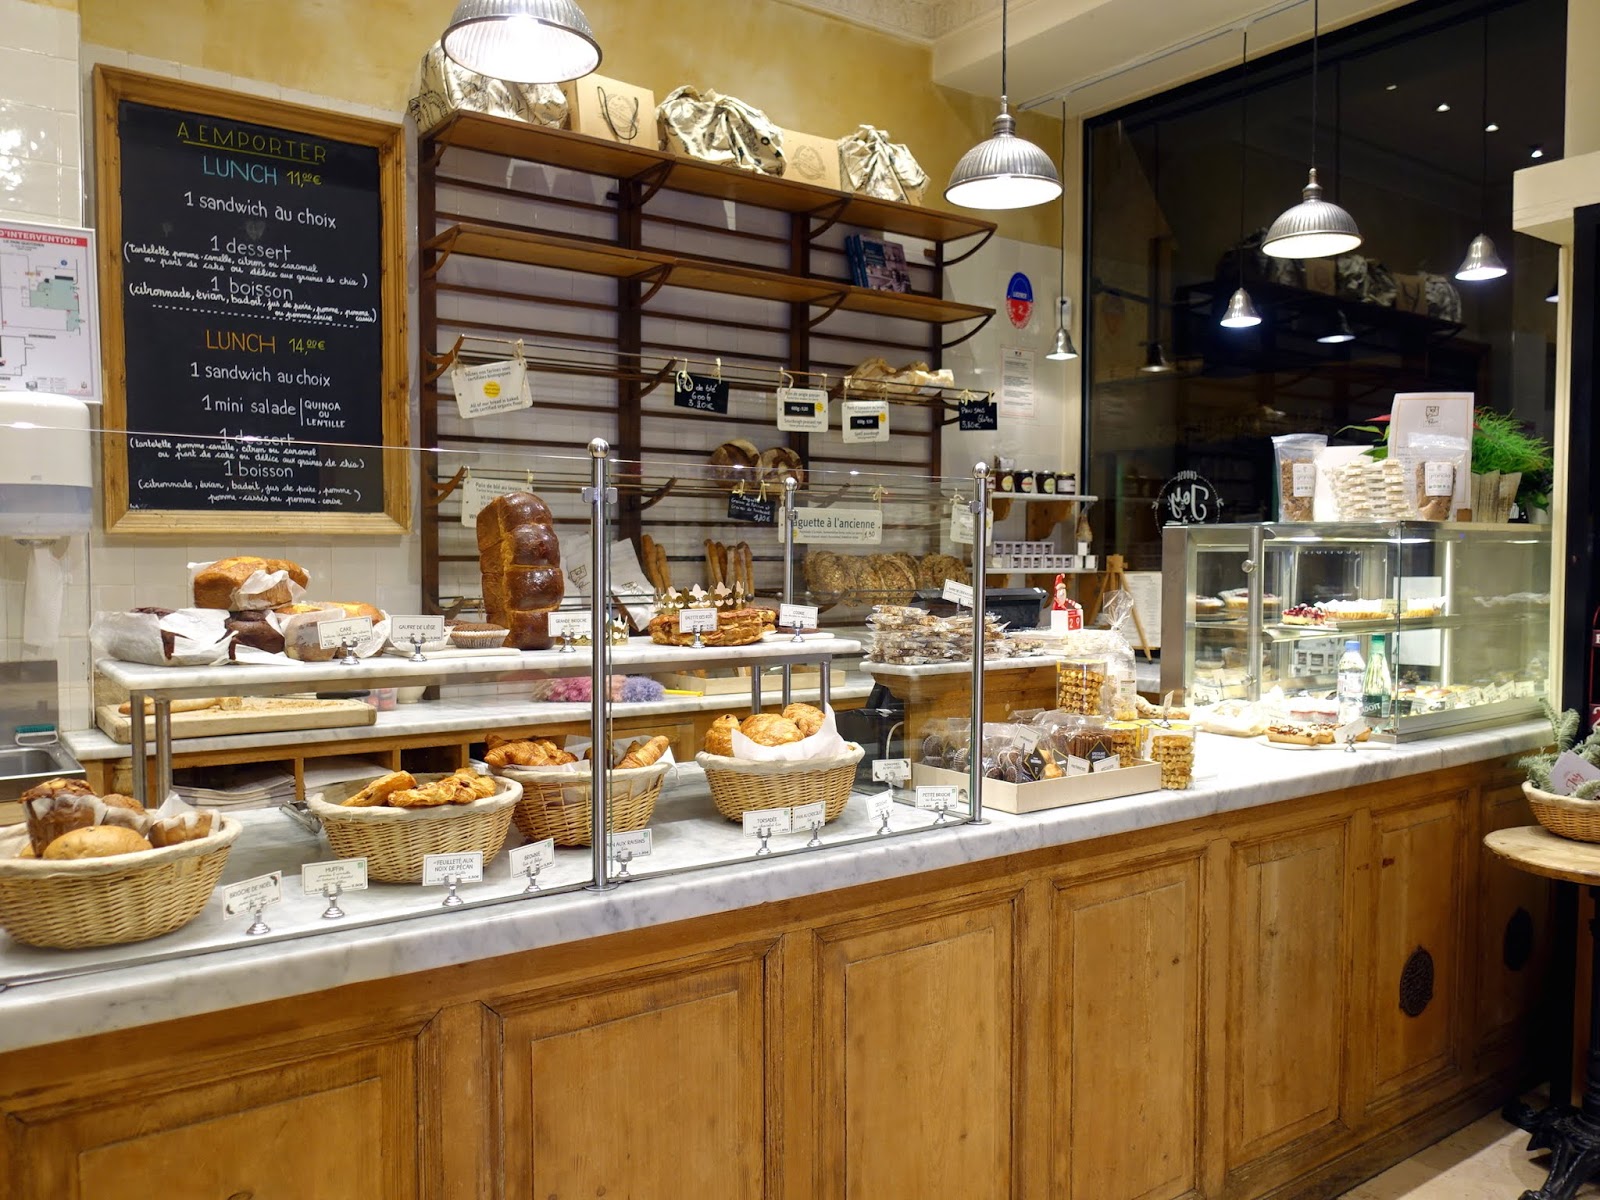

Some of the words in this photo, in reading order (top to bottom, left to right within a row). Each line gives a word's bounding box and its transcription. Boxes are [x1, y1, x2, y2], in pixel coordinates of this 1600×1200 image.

[177, 122, 189, 138] A
[200, 125, 326, 163] EMPORTER
[203, 156, 277, 185] LUNCH
[184, 191, 194, 206] 1
[200, 196, 268, 218] sandwich
[275, 206, 292, 221] au
[298, 208, 336, 229] choix
[211, 235, 219, 252] 1
[226, 237, 291, 261] dessert
[211, 276, 219, 292] 1
[229, 277, 293, 300] boisson
[206, 330, 276, 354] LUNCH
[190, 362, 199, 378] 1
[205, 365, 271, 383] sandwich
[278, 371, 293, 384] au
[296, 368, 331, 387] choix
[202, 394, 212, 411] 1
[215, 397, 243, 412] mini
[250, 399, 296, 415] salade
[304, 400, 341, 411] QUINOA
[306, 418, 345, 428] LENTILLE
[220, 427, 227, 444] 1
[235, 428, 295, 446] dessert
[223, 460, 233, 476] 1
[239, 461, 293, 478] boisson
[793, 518, 824, 529] aguette
[826, 517, 832, 527] à
[834, 517, 875, 529] l'ancienne
